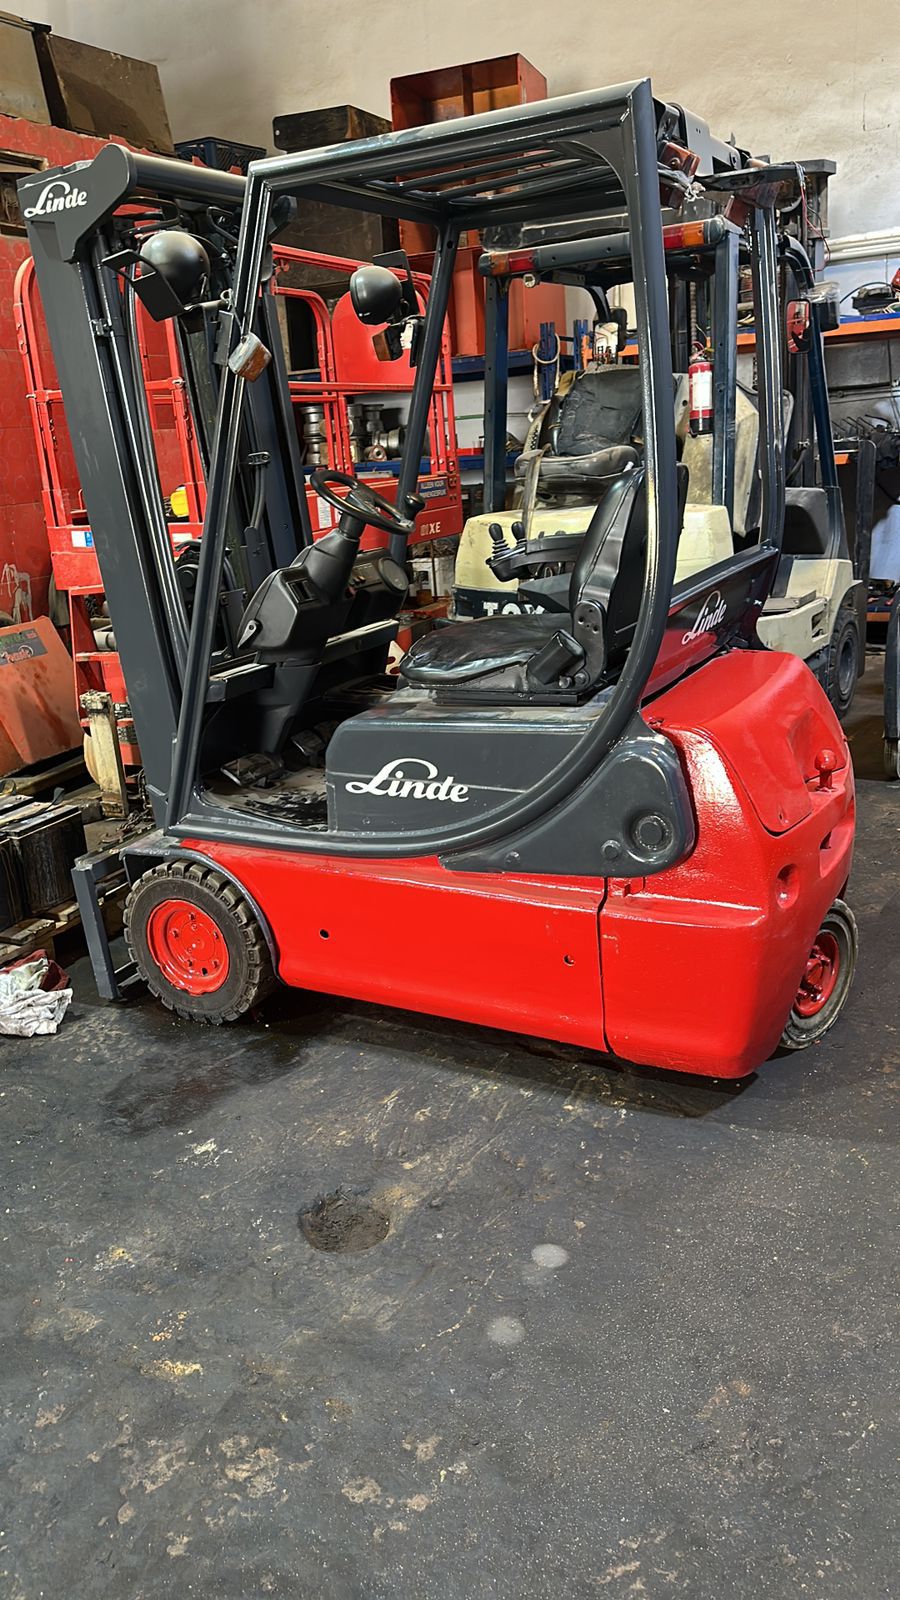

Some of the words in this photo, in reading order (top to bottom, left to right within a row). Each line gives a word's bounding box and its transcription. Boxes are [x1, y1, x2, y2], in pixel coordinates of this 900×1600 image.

[23, 181, 88, 218] Linde
[681, 590, 727, 645] Linde
[345, 757, 470, 803] Linde
